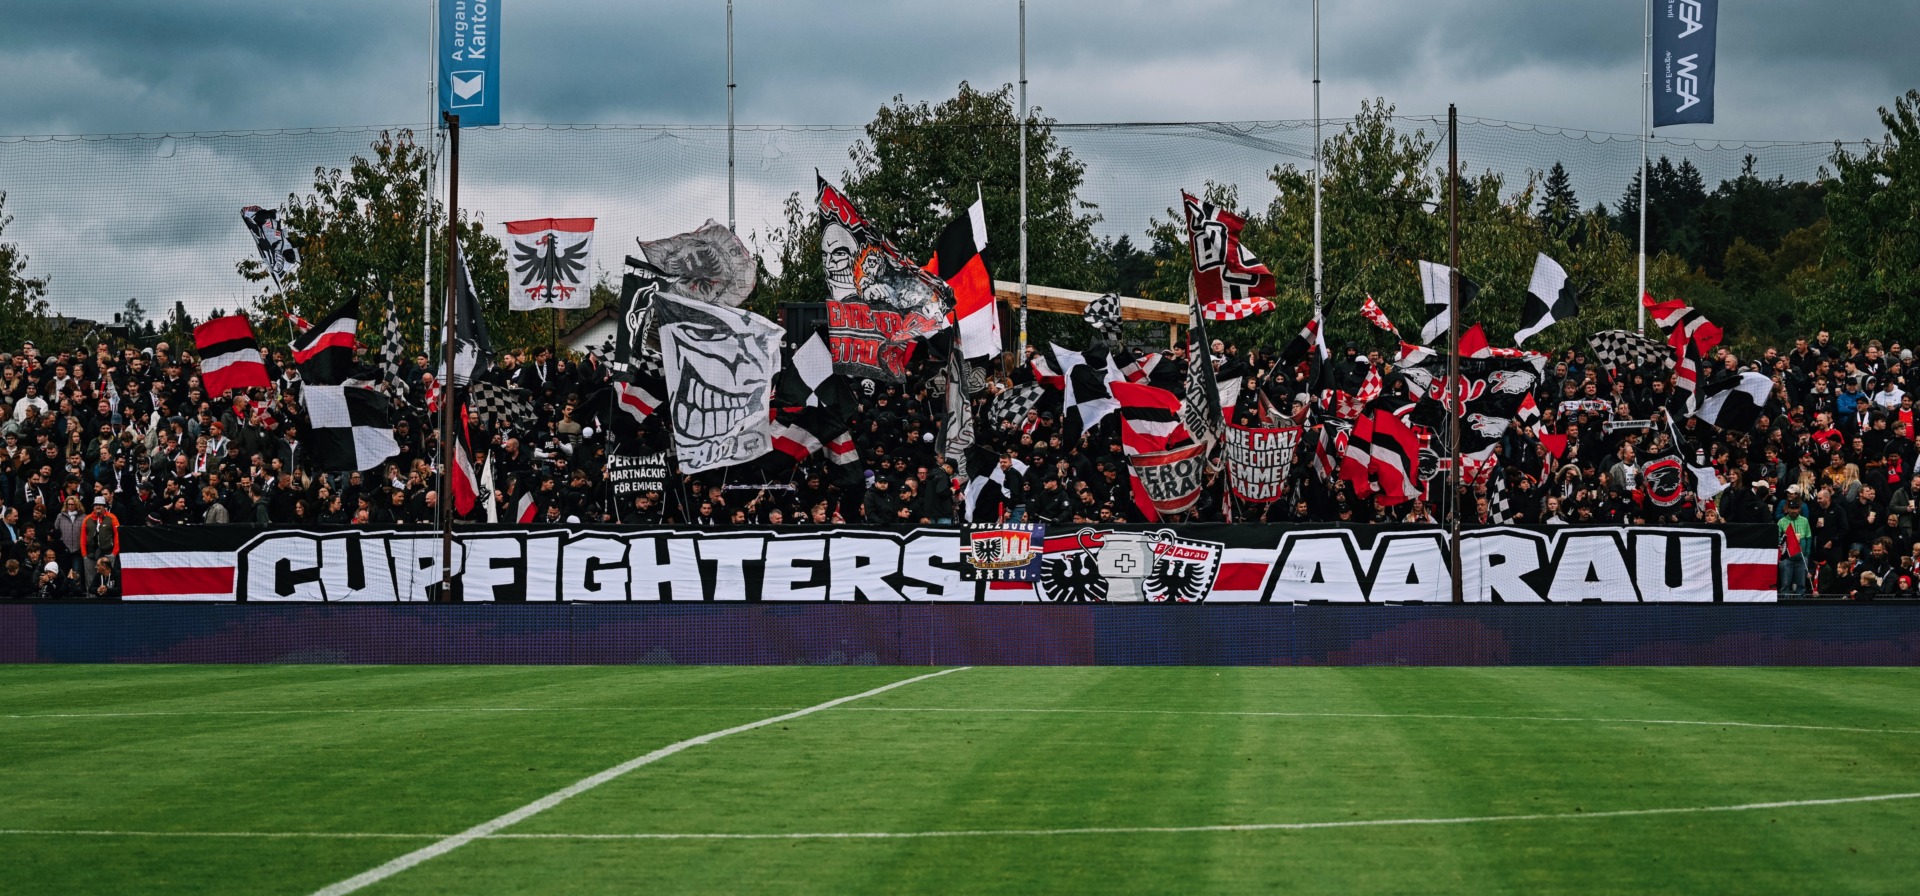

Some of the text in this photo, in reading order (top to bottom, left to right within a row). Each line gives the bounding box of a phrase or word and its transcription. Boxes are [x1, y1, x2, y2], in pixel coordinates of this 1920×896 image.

[468, 0, 487, 59] Kanto
[1225, 426, 1298, 451] NIE GANZ
[607, 452, 666, 469] PERTINAX
[1228, 458, 1291, 484] EMMER
[610, 466, 666, 482] HARTNÄCKIG
[614, 481, 663, 494] FÖR EMMER
[1231, 474, 1280, 500] PARAT
[1175, 548, 1207, 559] Aarau
[247, 534, 1713, 601] CUPFIGHTERS AARAU
[975, 569, 1027, 580] AARAU
